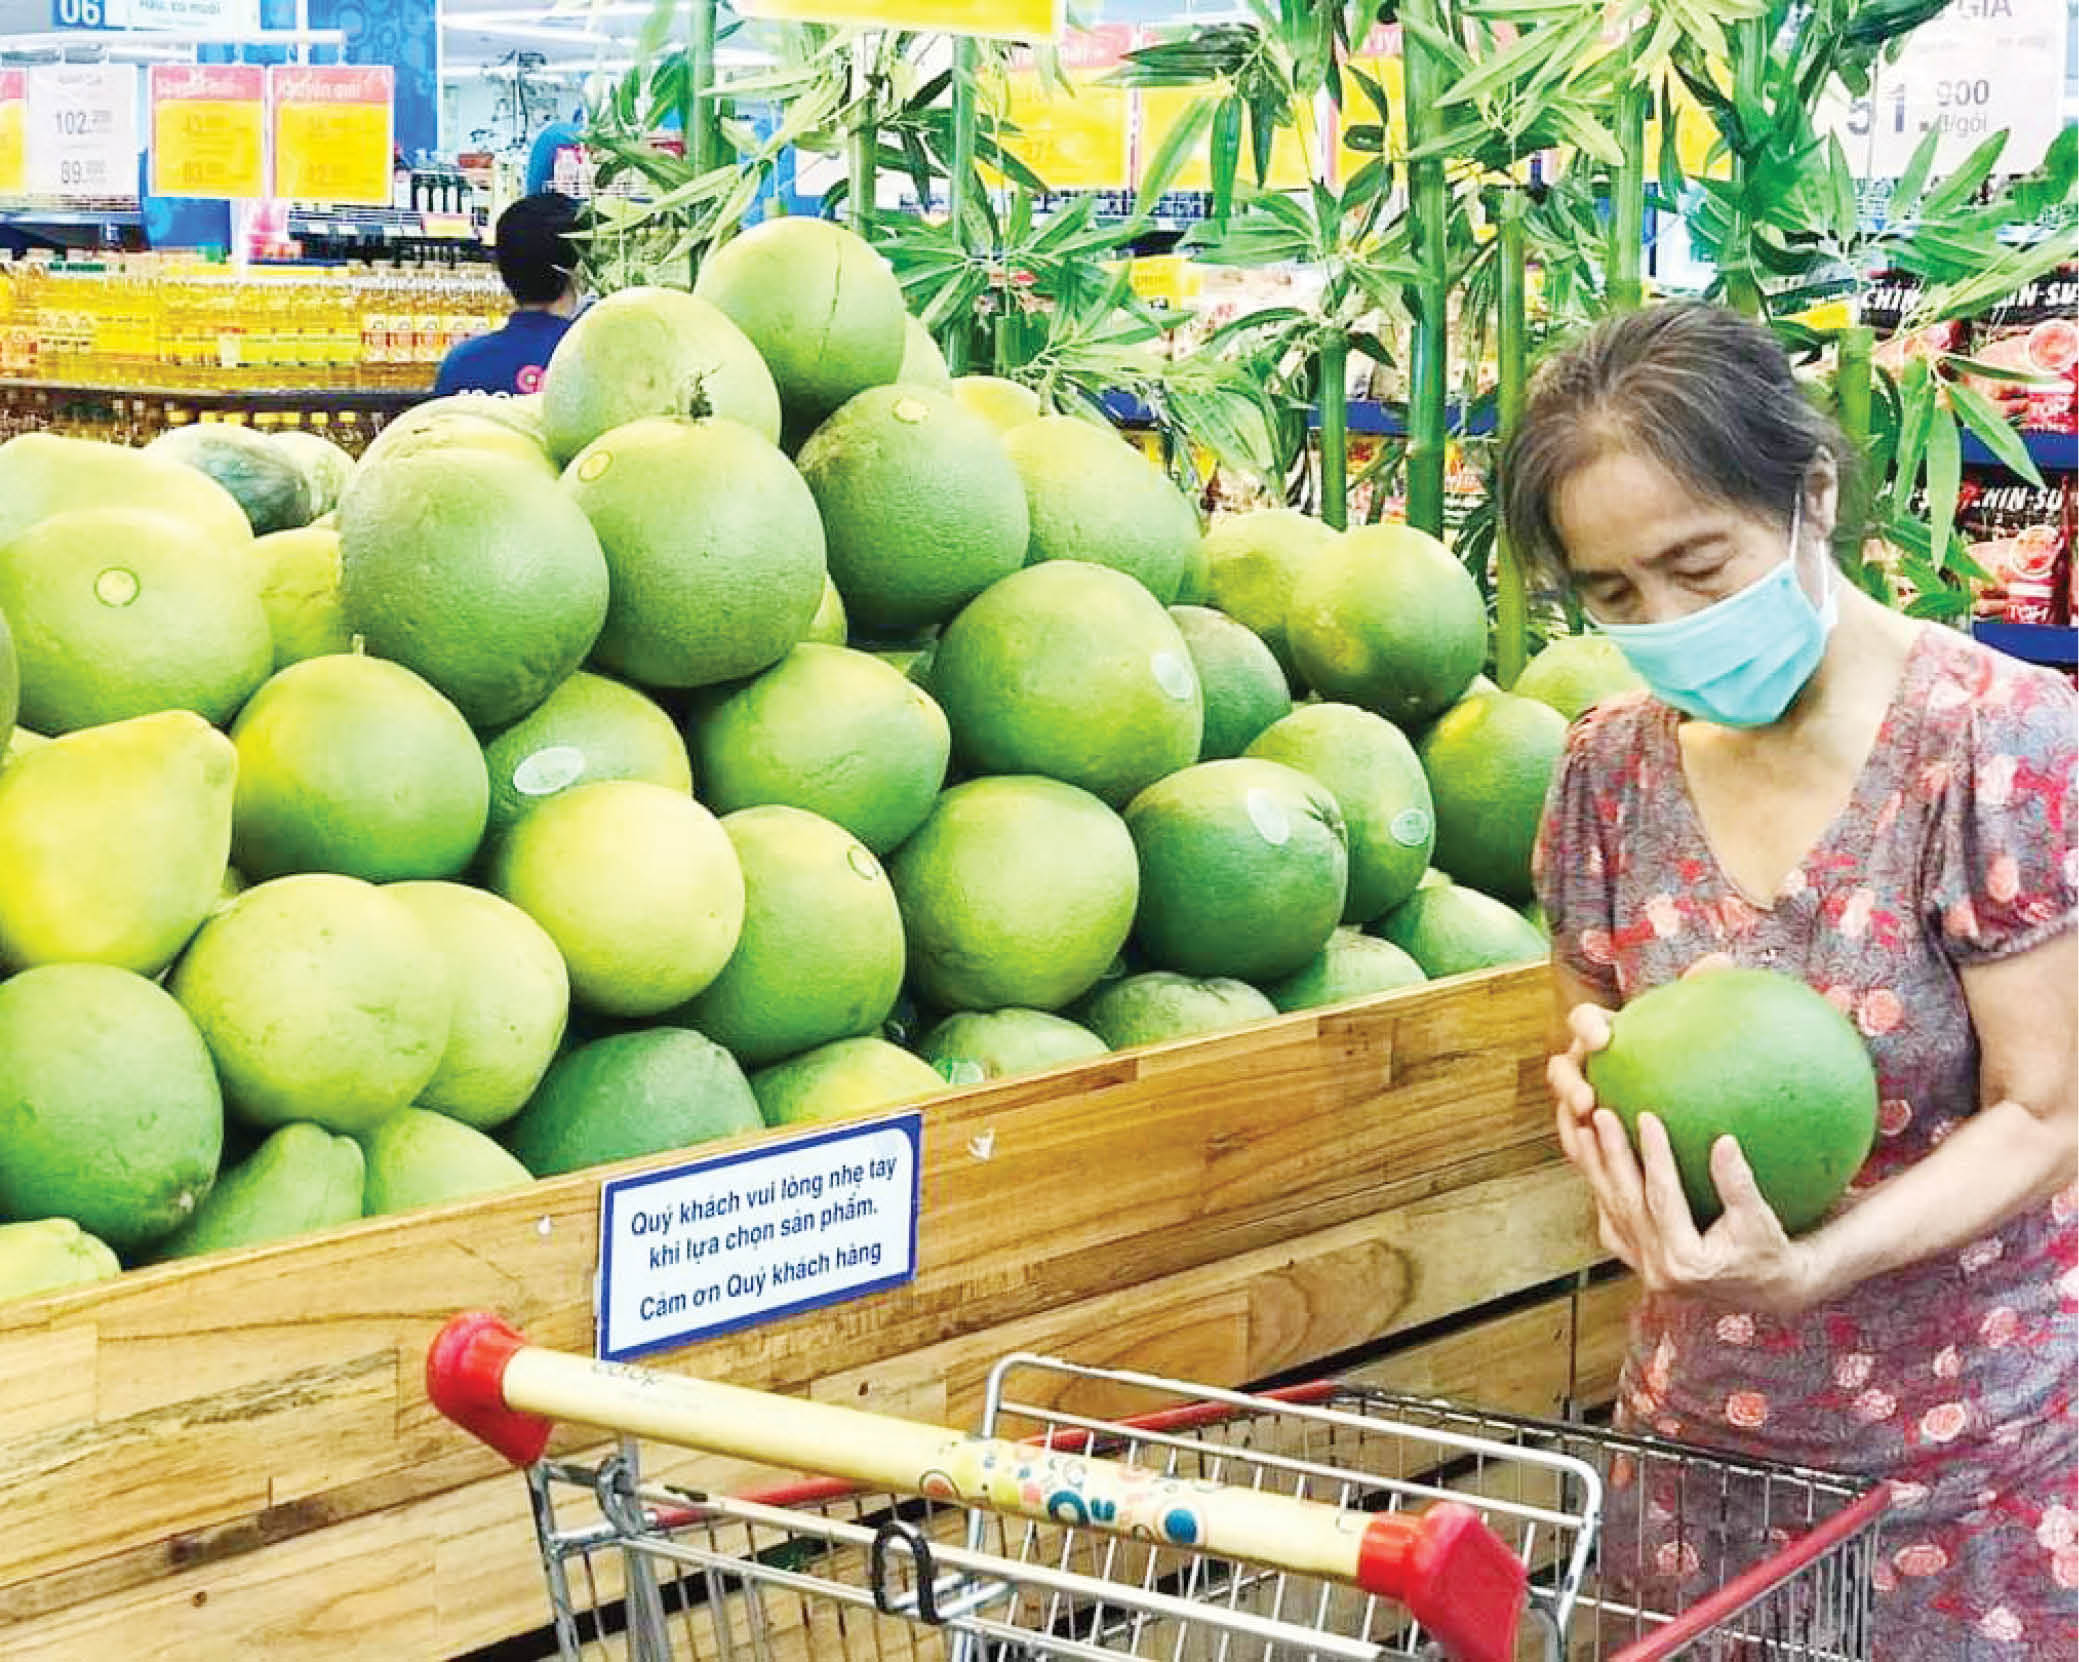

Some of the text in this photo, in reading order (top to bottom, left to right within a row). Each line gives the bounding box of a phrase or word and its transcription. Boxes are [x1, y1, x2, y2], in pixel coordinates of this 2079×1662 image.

[60, 0, 100, 25] 06
[631, 1156, 898, 1235] Quý khách vui lòng nhẹ tay
[649, 1191, 879, 1269] khi lựa chọn sản phẩm.
[640, 1243, 881, 1321] Cảm ơn Quý khách hàng
